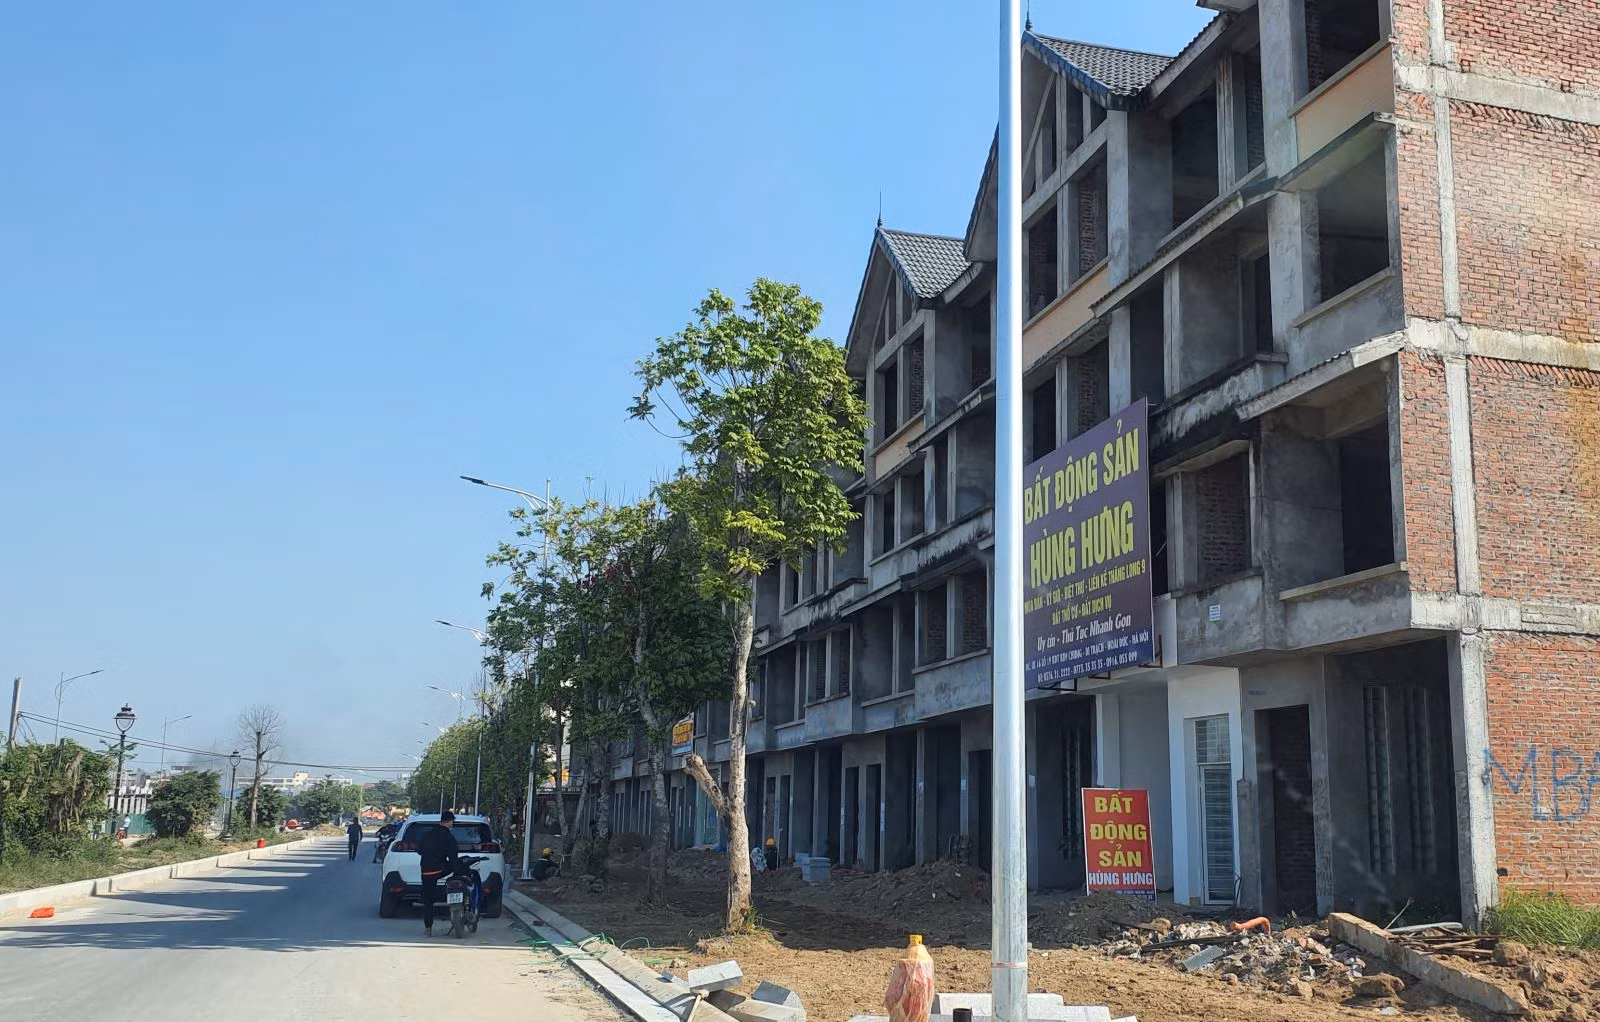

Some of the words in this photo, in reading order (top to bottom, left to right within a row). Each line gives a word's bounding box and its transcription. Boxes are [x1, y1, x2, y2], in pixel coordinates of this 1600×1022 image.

[1024, 466, 1051, 525] BẤT
[1055, 451, 1098, 512] ĐỘNG
[1103, 418, 1139, 486] SẢN
[1030, 527, 1076, 589] HÙNG
[1080, 501, 1134, 570] HƯNG
[1126, 560, 1141, 579] LONG
[1141, 558, 1146, 573] 9
[1090, 616, 1113, 637] Nhanh
[1115, 613, 1132, 631] Gọn
[1094, 791, 1133, 814] BẤT
[1089, 820, 1147, 844] ĐỘNG
[1098, 843, 1142, 868] SẢN
[1088, 869, 1120, 886] HÙNG
[1122, 871, 1153, 886] HƯNG
